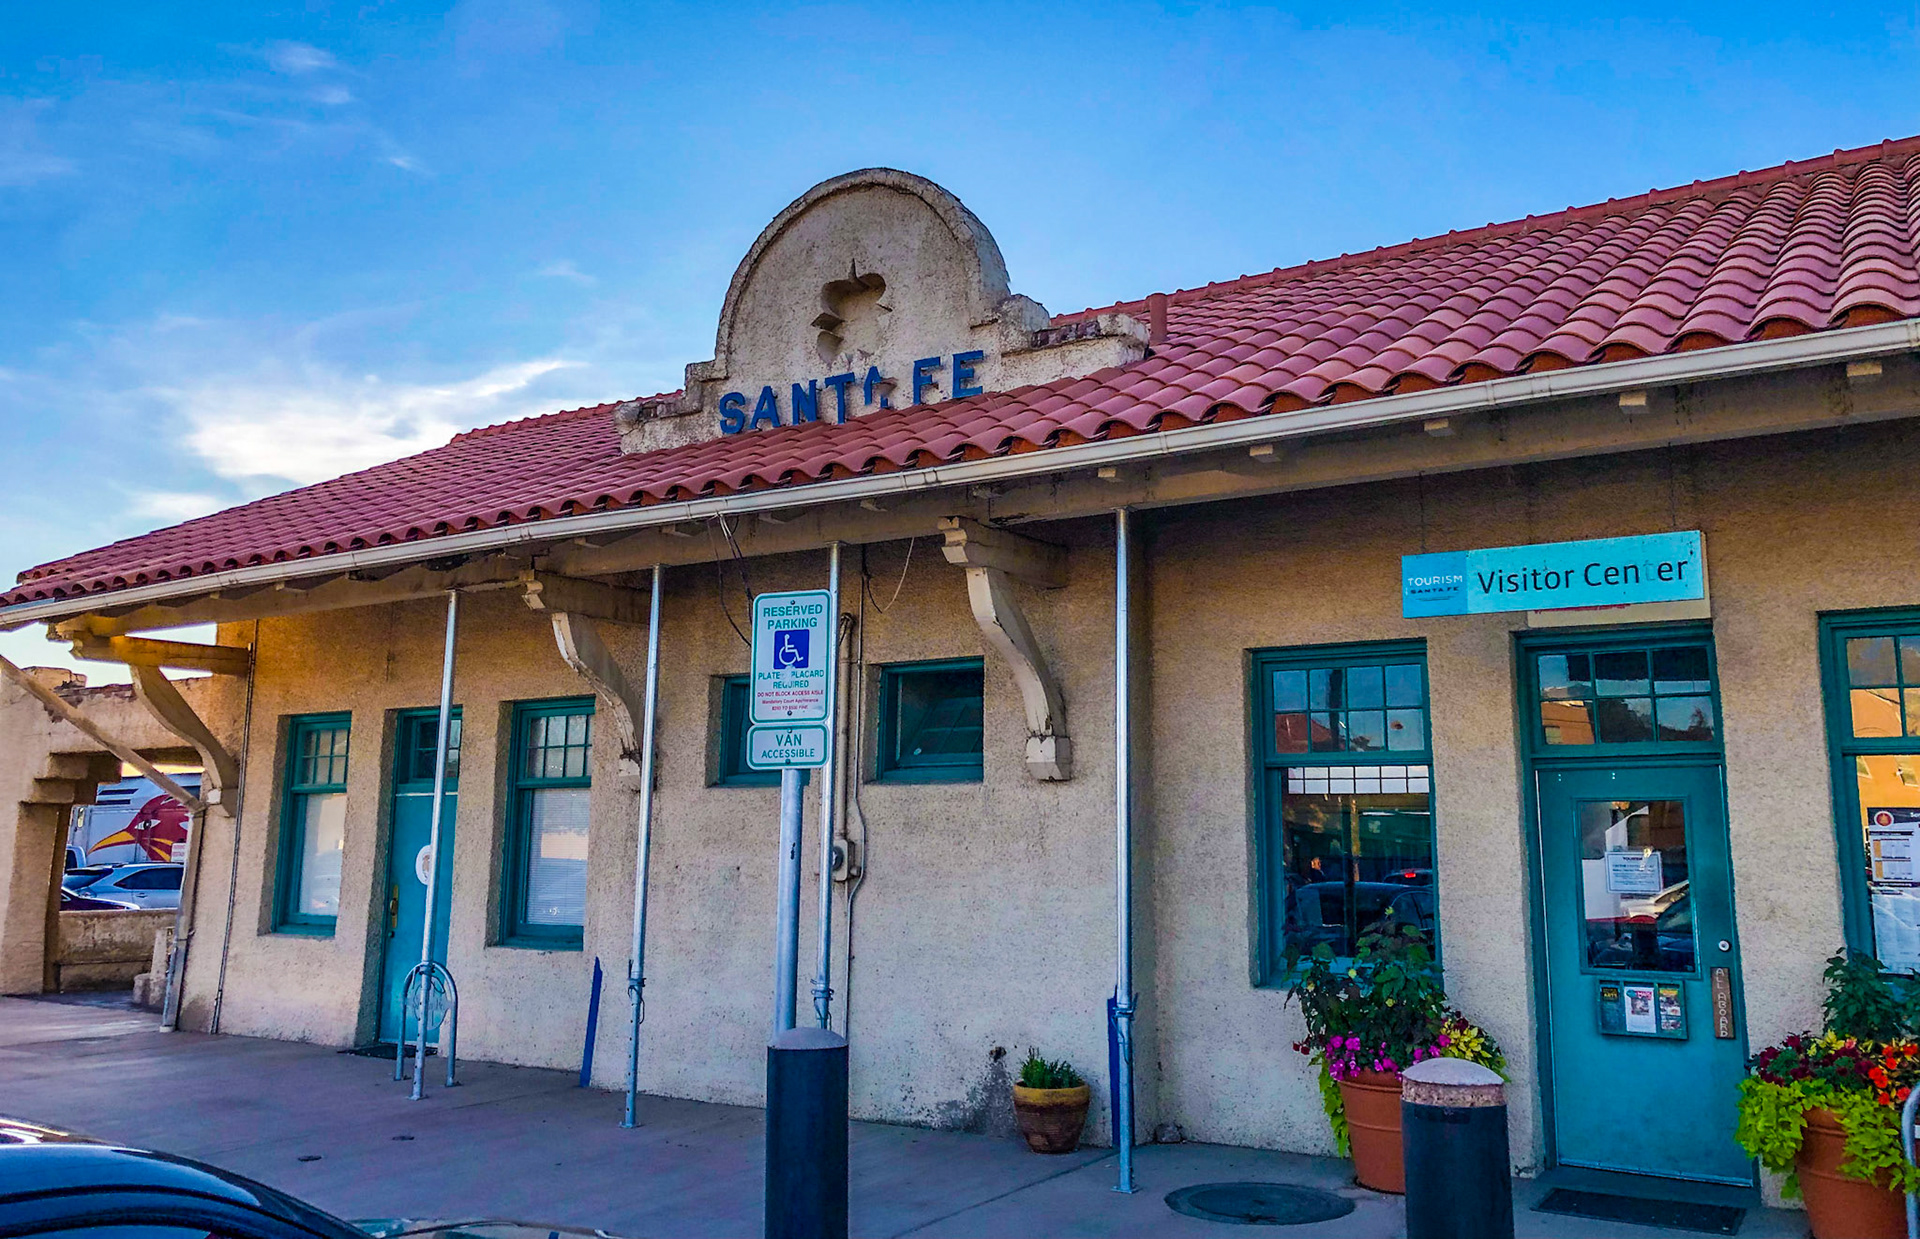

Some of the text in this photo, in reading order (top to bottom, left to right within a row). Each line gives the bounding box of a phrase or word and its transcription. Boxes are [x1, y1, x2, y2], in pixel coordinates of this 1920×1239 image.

[912, 350, 984, 405] FE
[1407, 574, 1463, 587] TOURISM
[1477, 568, 1575, 594] Visitor
[1410, 587, 1444, 595] SANTA
[763, 603, 823, 618] RESERVED
[767, 616, 818, 631] PARKING
[757, 671, 781, 680] PLATE
[790, 669, 825, 679] PLACARD
[776, 734, 802, 747] VAN
[761, 748, 815, 759] ACCESSIBLE
[1716, 968, 1729, 1038] ALL ABOARD
